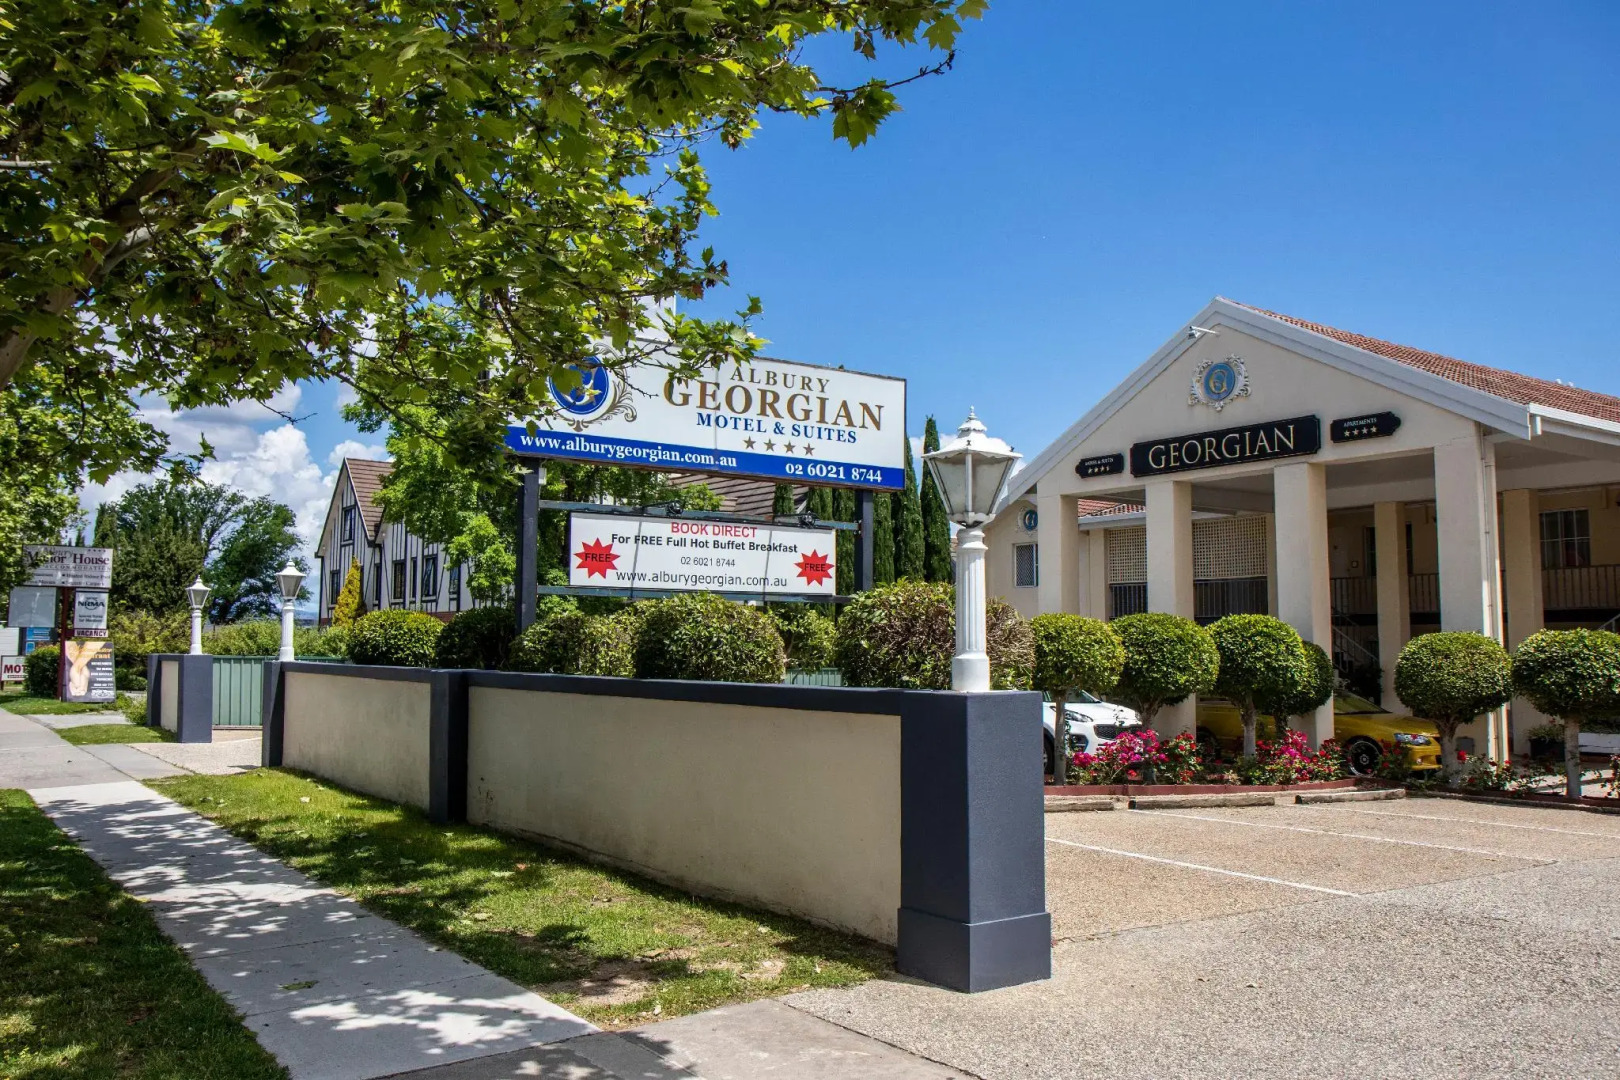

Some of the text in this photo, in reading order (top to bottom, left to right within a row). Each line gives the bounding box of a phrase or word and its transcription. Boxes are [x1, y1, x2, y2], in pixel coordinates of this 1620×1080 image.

[730, 366, 830, 393] ALBURY
[663, 377, 885, 431] GEORGIAN
[696, 411, 857, 444] MOTEL & SUITES
[520, 435, 737, 468] www.alburygeorgian.com.au
[1148, 424, 1295, 469] GEORGIAN
[785, 463, 882, 483] 02 6021 8744
[671, 521, 758, 538] BOOK DIRECT
[611, 533, 798, 553] For FREE Full Hot Buffet Breakfast
[73, 553, 110, 565] House
[584, 552, 611, 562] FREE
[680, 556, 736, 567] 02 6021 8744
[804, 562, 826, 572] FREE
[616, 571, 787, 587] www.alburygeorgian.com.au
[77, 629, 107, 637] VACANCY
